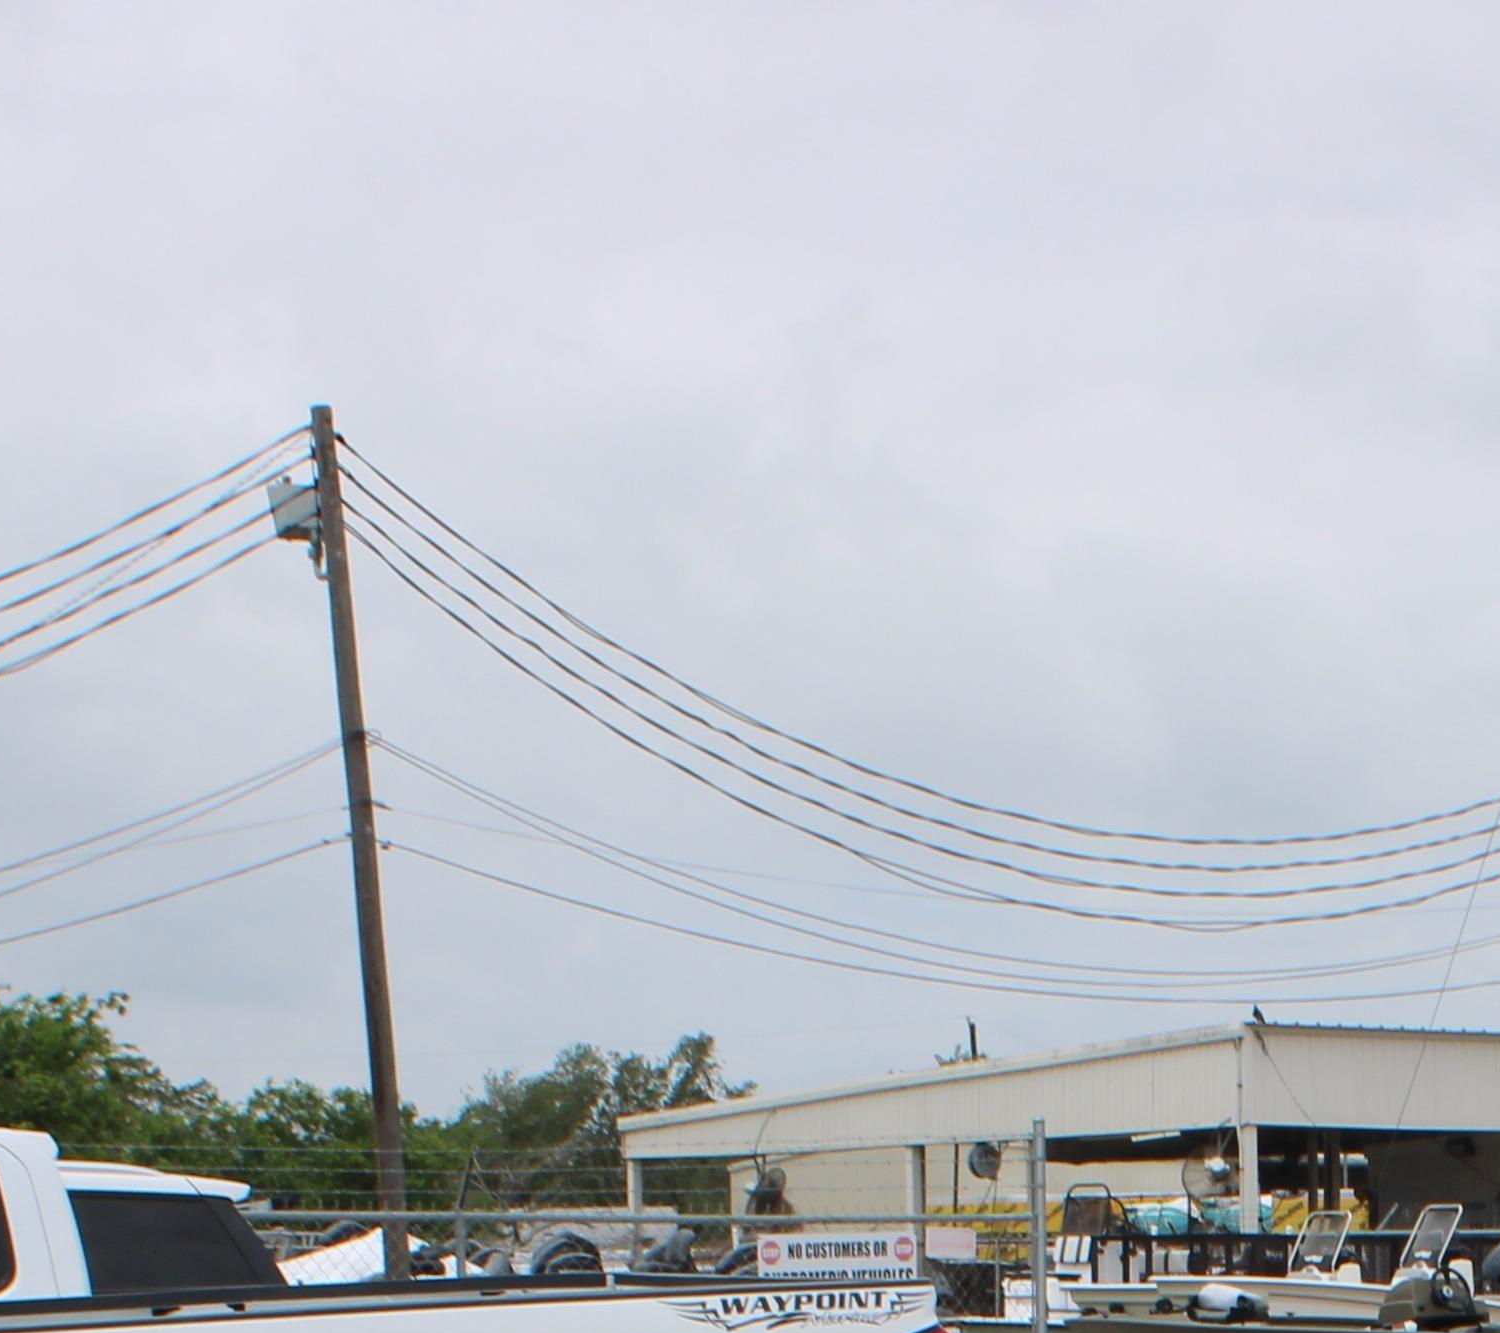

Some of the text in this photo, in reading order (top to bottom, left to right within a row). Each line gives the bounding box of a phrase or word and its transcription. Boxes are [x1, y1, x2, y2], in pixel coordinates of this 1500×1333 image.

[787, 1240, 888, 1260] NO CUSTOMERS OR
[718, 1291, 889, 1316] WAYPOINT
